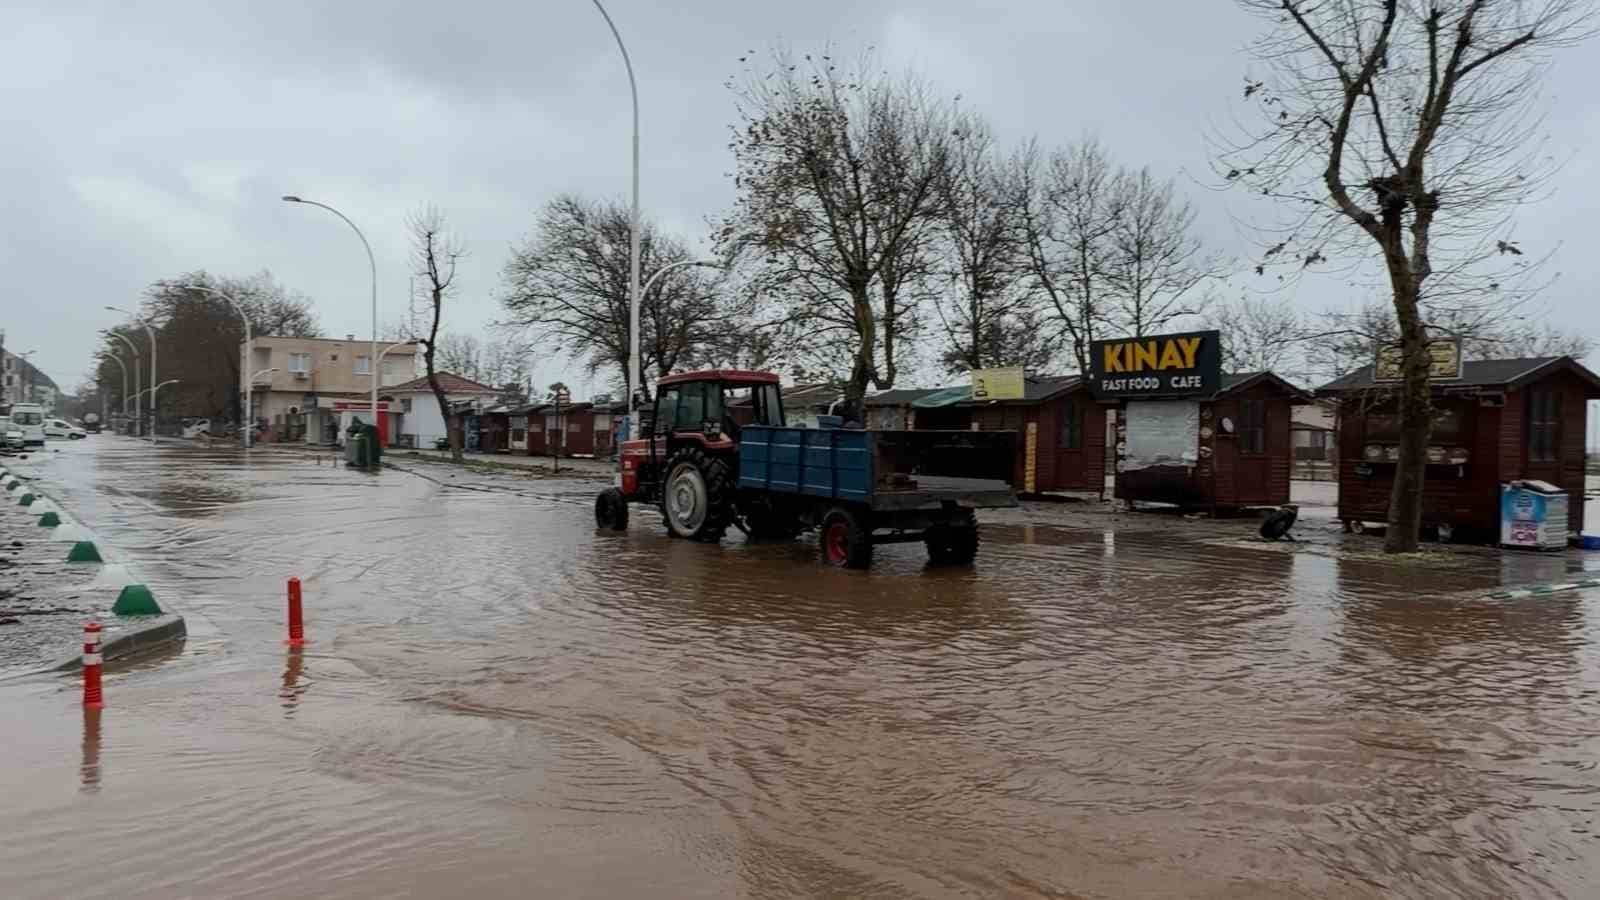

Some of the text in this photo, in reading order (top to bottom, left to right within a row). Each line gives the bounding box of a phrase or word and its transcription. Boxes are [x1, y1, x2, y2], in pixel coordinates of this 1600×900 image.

[1104, 338, 1201, 373] KINAY
[1102, 375, 1202, 391] FAST FOOD CAFE
